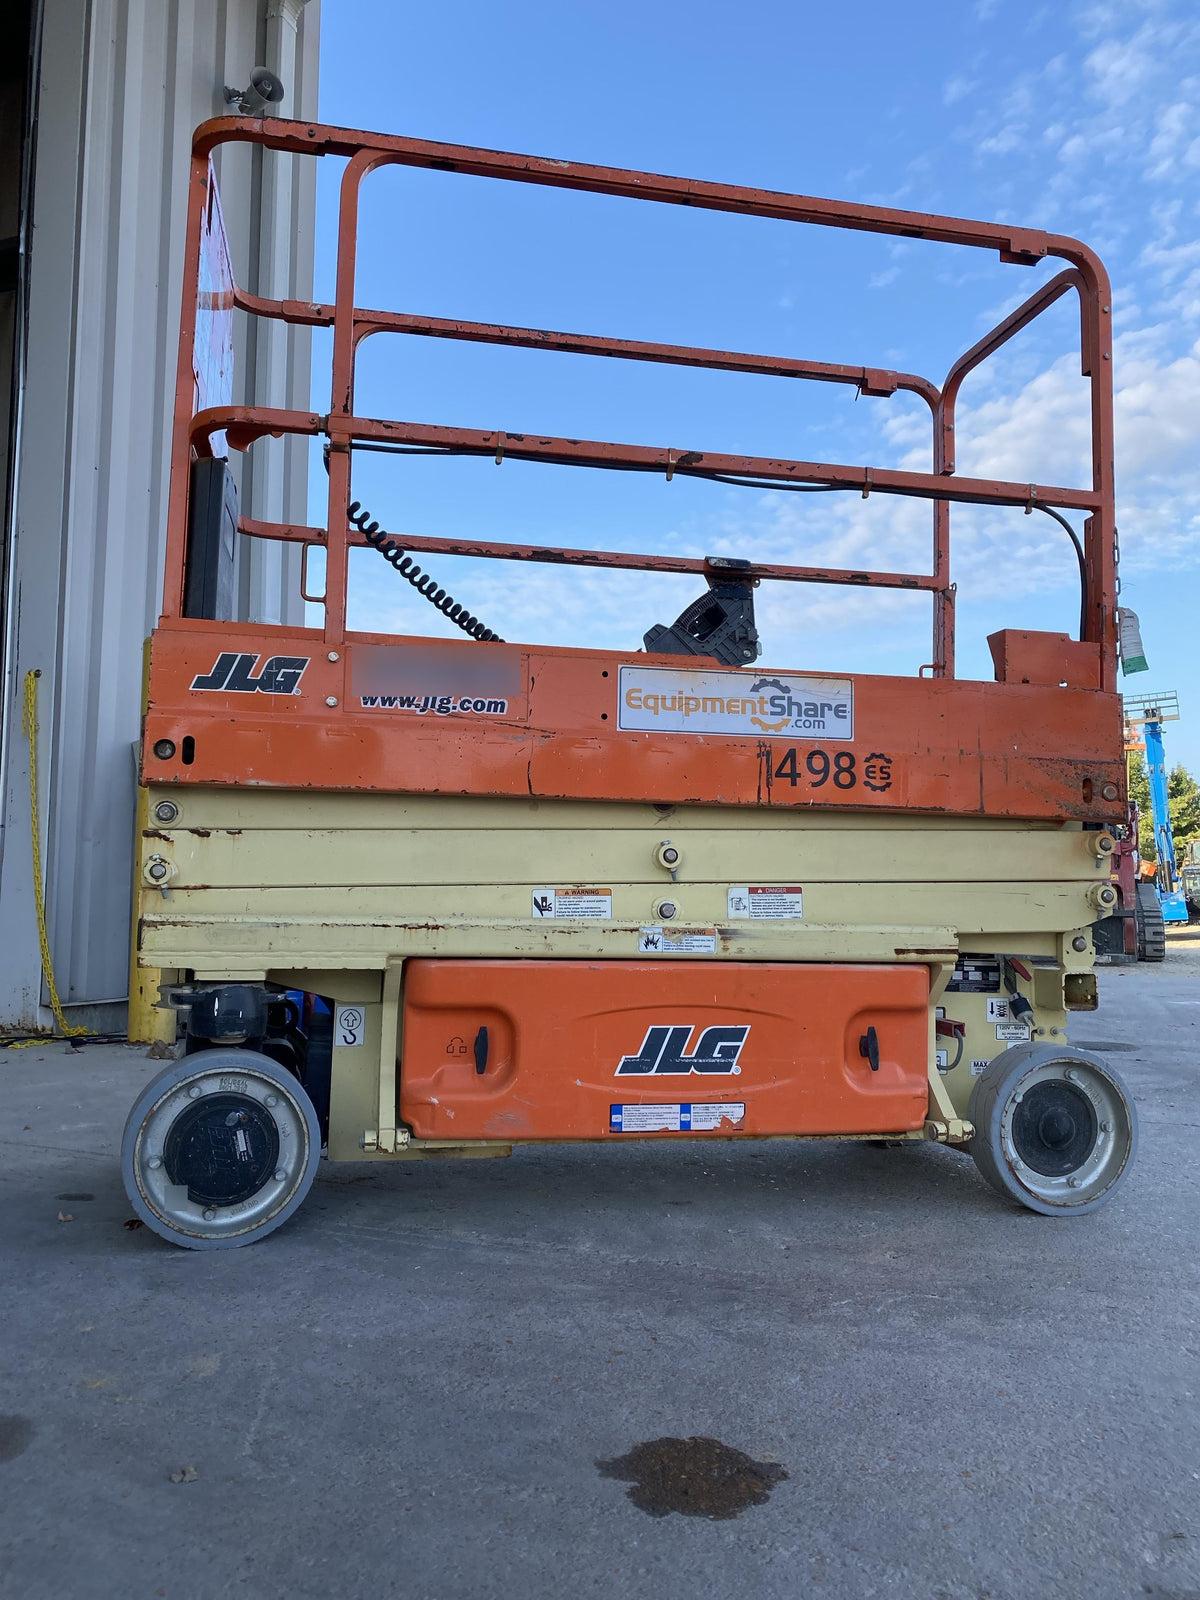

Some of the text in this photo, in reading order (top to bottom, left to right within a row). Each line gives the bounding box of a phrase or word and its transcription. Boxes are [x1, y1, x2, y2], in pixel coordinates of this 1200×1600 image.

[189, 652, 311, 695] JLG
[361, 696, 507, 714] www.jlg.com
[625, 687, 847, 719] EquipmentShare
[614, 1025, 751, 1076] JLG
